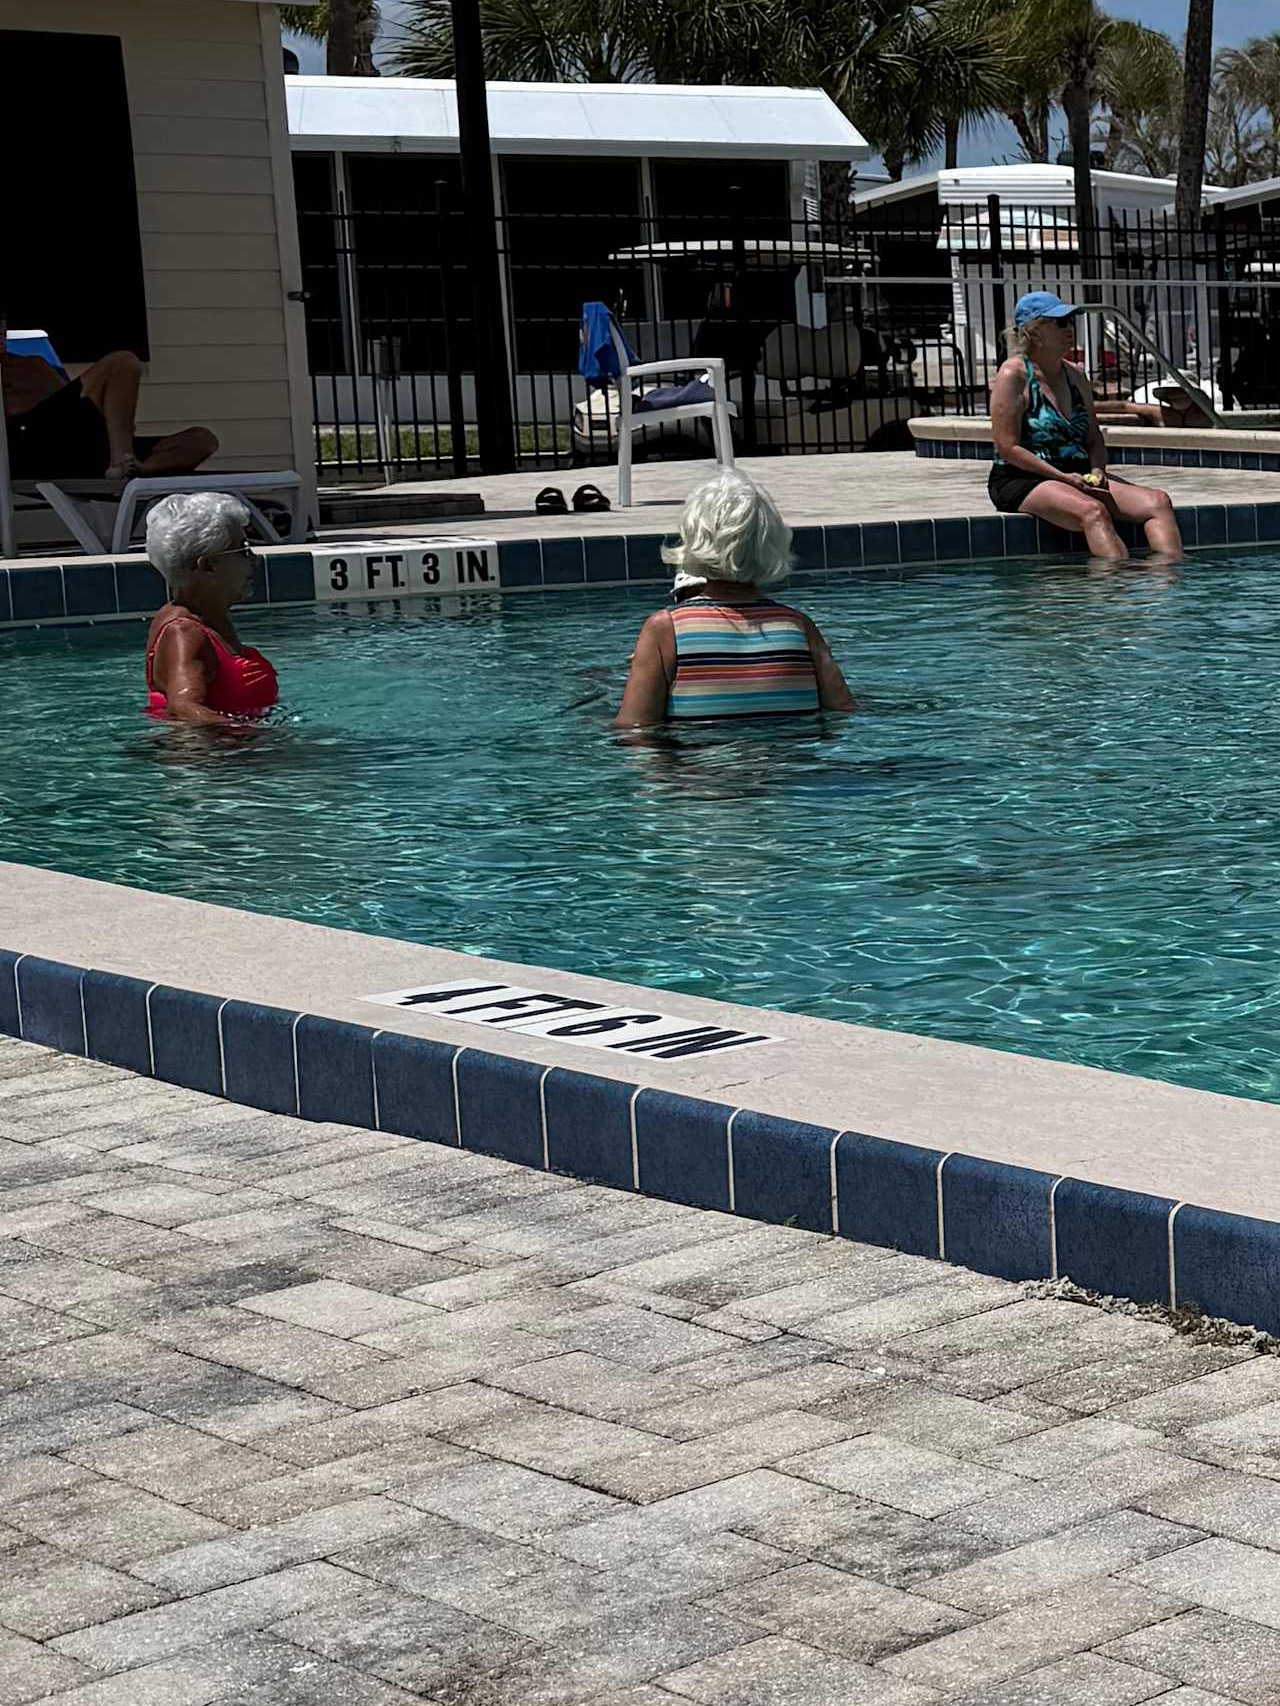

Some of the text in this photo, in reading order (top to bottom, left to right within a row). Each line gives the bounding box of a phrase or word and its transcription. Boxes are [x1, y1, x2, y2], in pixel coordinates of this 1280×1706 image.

[329, 550, 495, 591] 3 FT. 3 IN.
[395, 984, 773, 1059] 4 FT 6 IN
